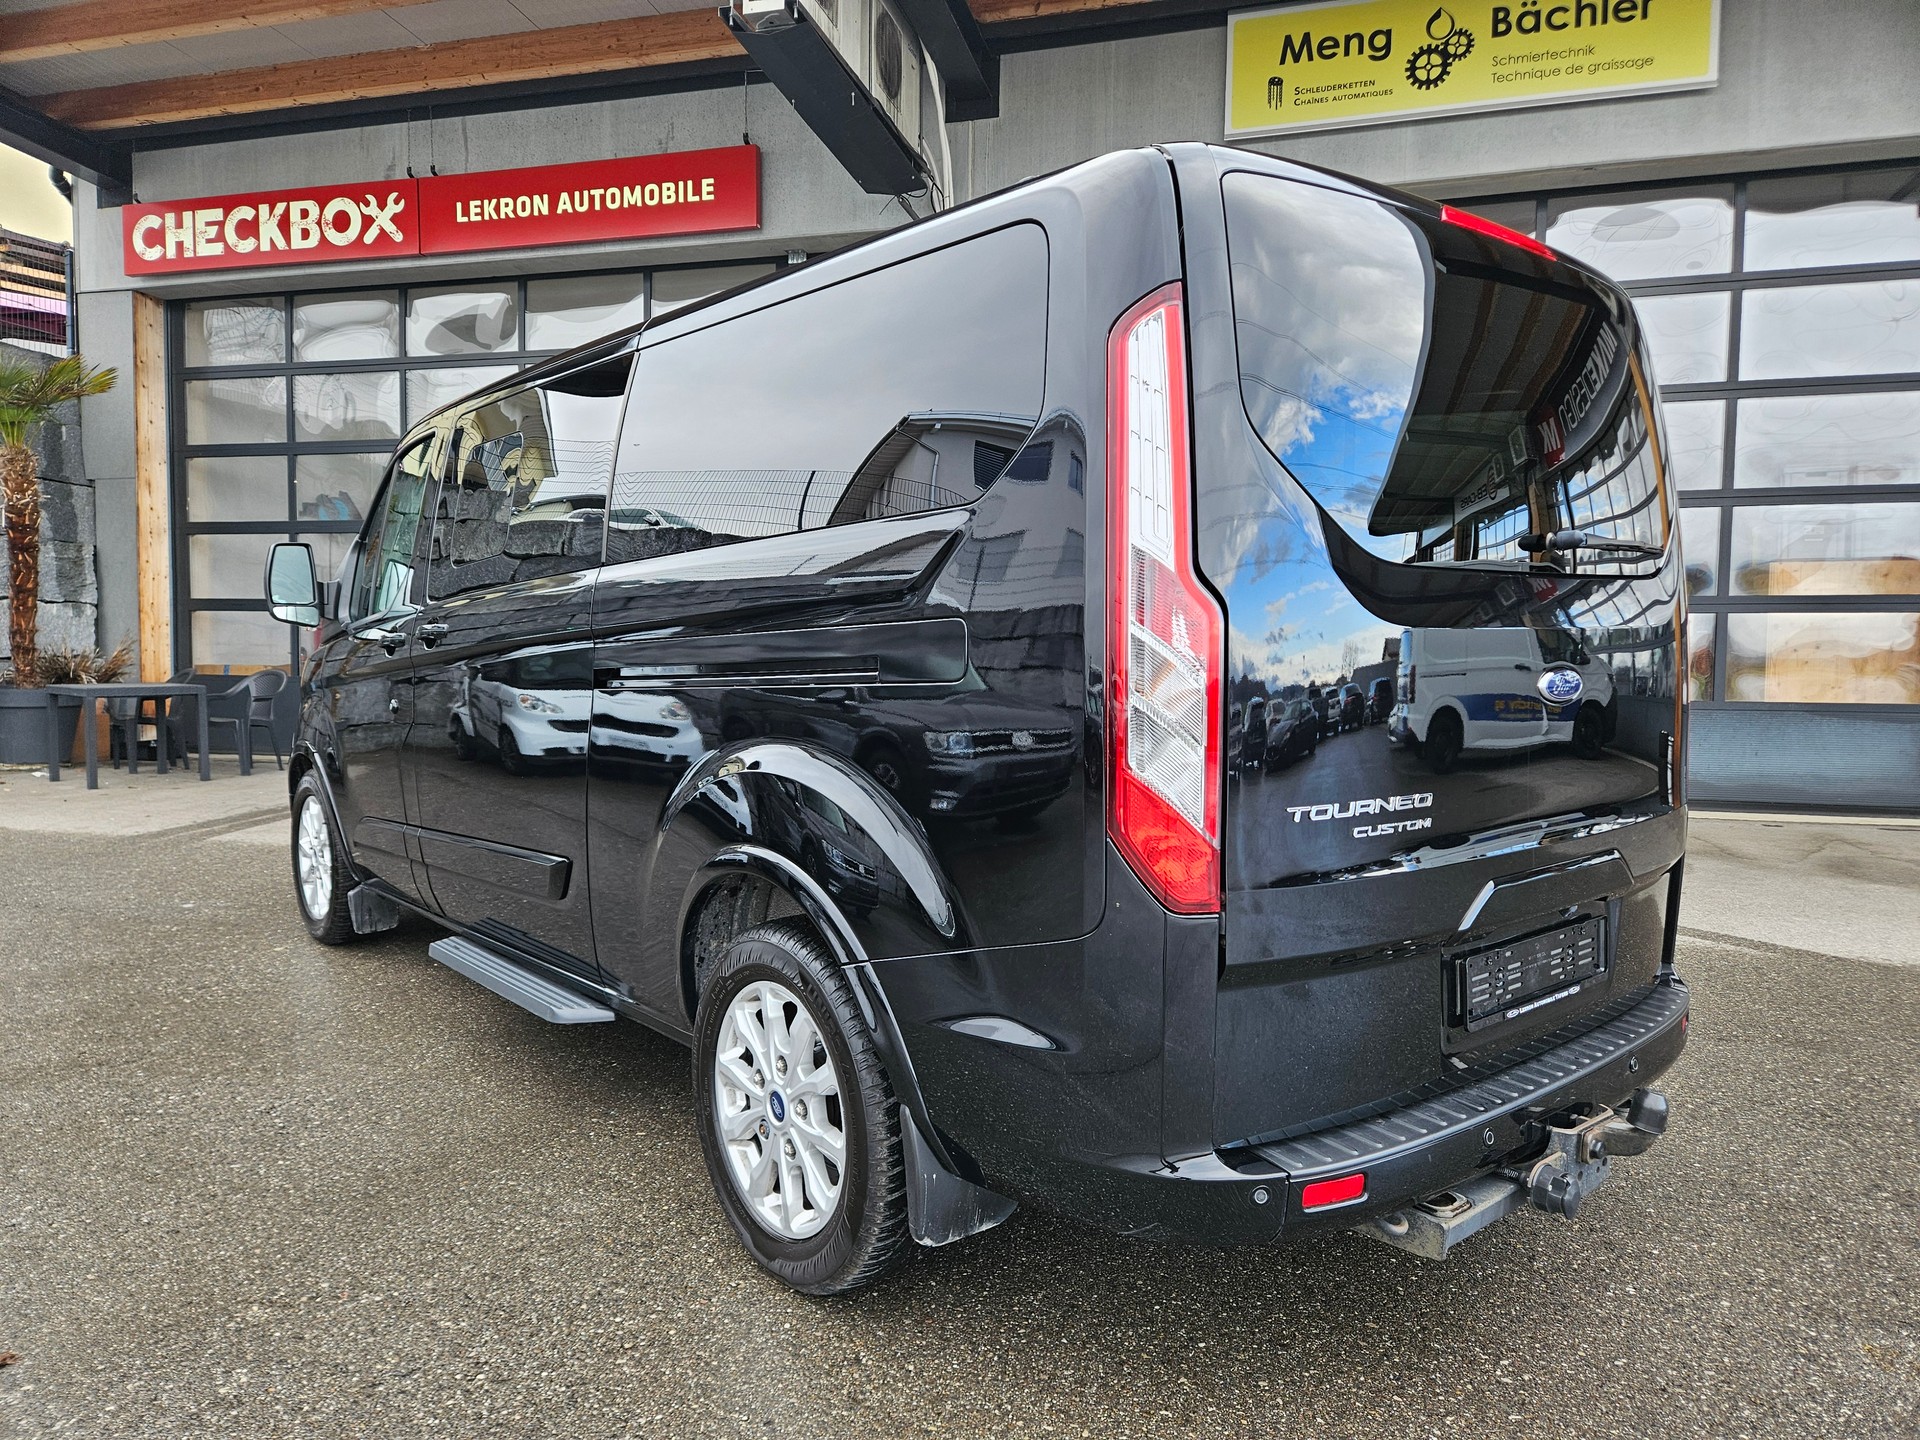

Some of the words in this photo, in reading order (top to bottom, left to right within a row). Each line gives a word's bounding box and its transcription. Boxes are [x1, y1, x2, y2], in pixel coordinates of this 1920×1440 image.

[1490, 0, 1654, 39] Bächler
[1278, 28, 1393, 66] Meng
[1491, 44, 1596, 68] Schmiertechnik
[1490, 64, 1561, 85] Technique
[1564, 60, 1584, 76] de
[1587, 55, 1655, 76] graissage
[1331, 88, 1394, 103] AUTOMATIQUES
[456, 193, 549, 223] LEKRON
[556, 177, 715, 214] AUTOMOBILE
[132, 191, 405, 262] CHECKBOX
[1285, 792, 1434, 823] TOURNEO
[1352, 817, 1433, 839] CUSTOM
